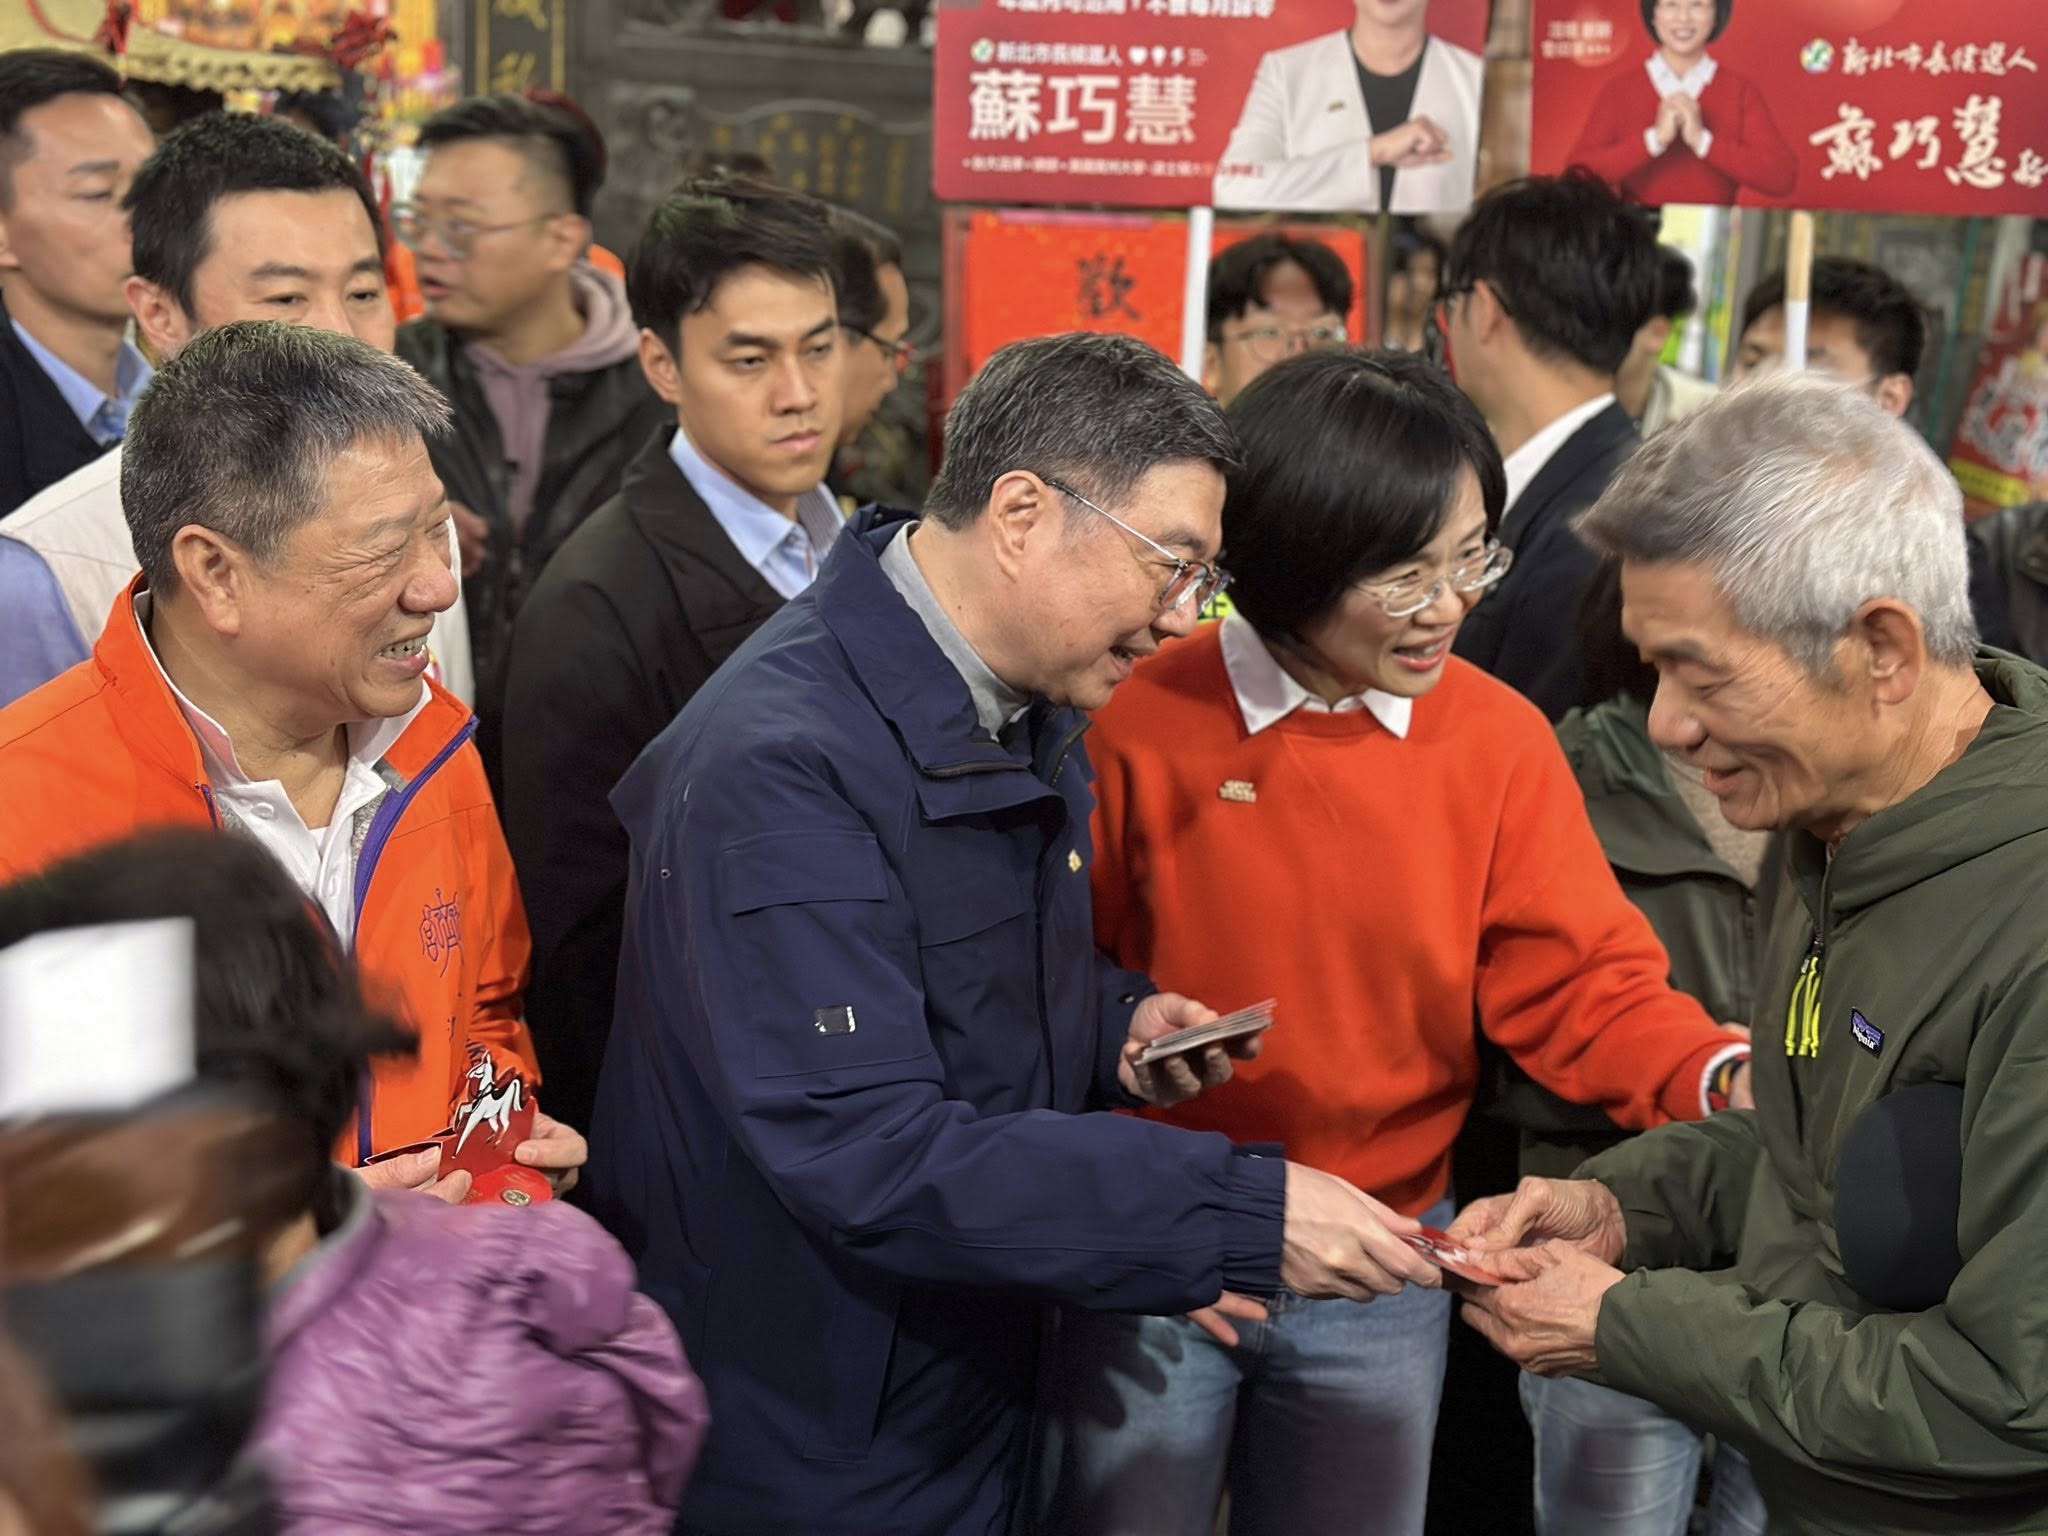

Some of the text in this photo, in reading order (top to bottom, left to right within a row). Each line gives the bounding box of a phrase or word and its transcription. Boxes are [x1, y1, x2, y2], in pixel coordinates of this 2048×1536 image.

[997, 41, 1123, 66] 新北市長候選人
[1842, 37, 2039, 77] 新北市長候選人
[968, 68, 1196, 145] 蘇巧慧
[1808, 93, 2006, 188] 蘇巧慧
